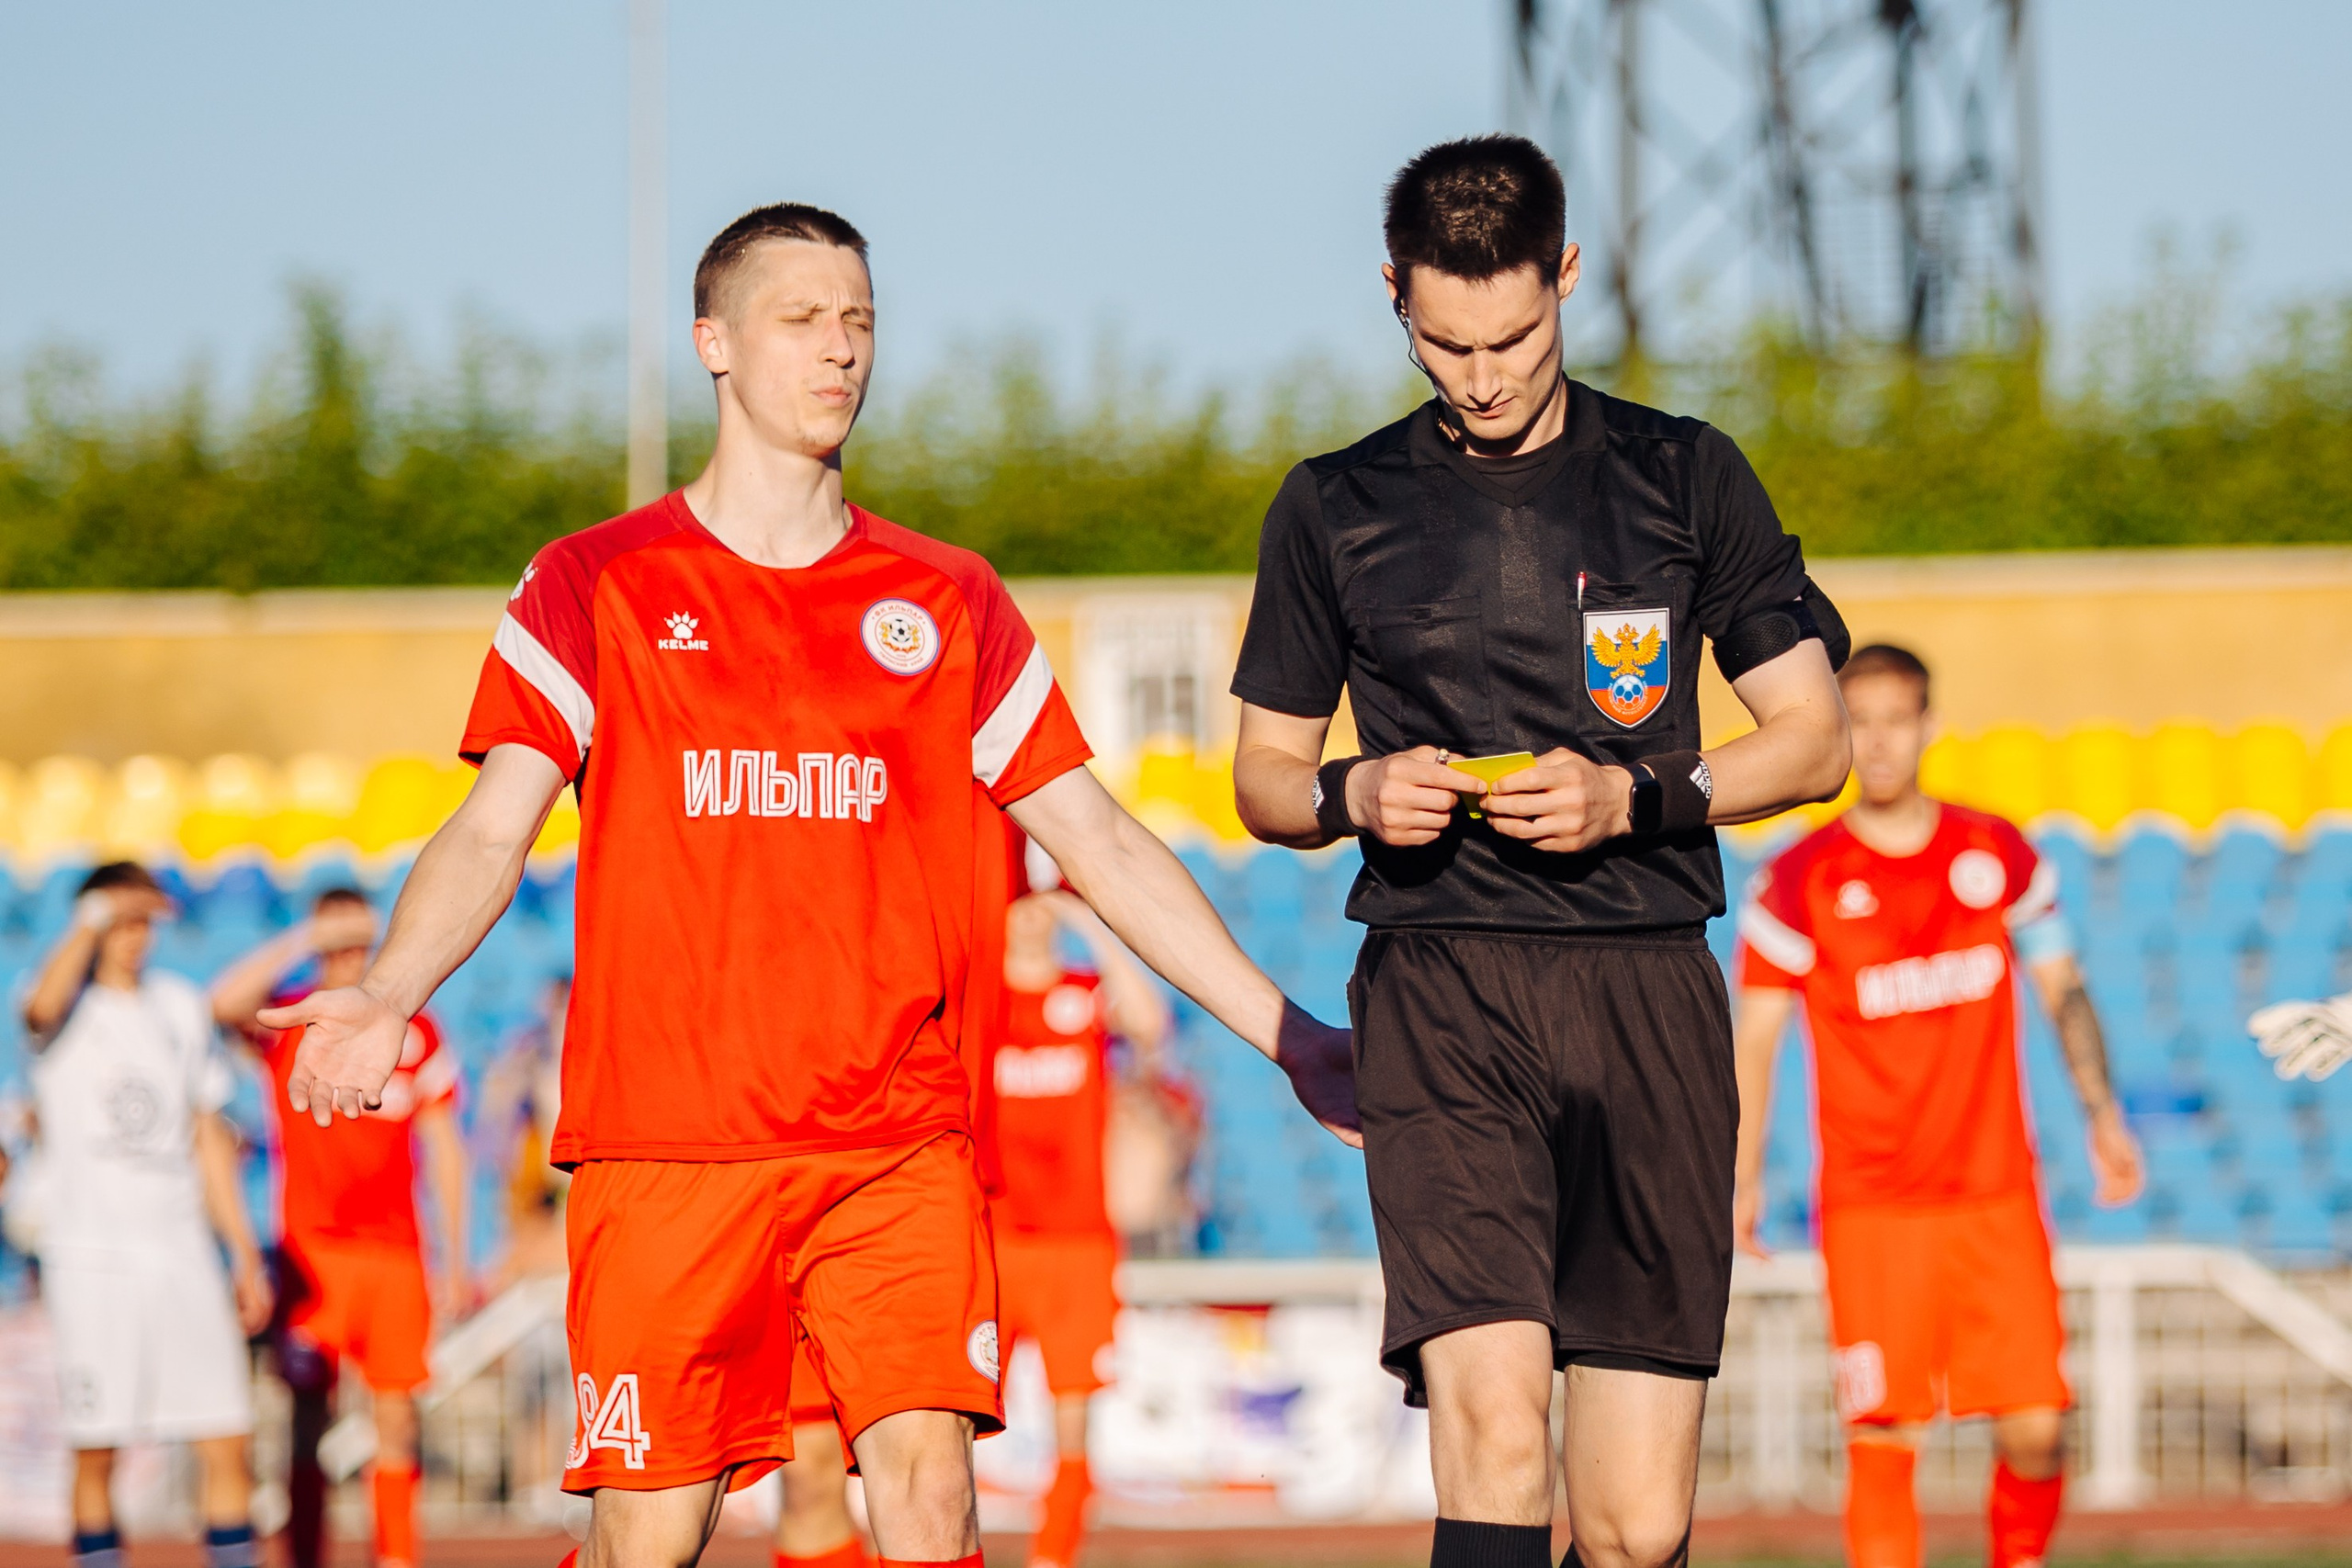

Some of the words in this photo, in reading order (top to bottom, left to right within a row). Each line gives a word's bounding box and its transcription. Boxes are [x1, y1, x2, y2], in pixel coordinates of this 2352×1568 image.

[658, 639, 709, 651] KELME
[683, 749, 888, 823] ИЛЬПАР
[564, 1371, 650, 1471] 94
